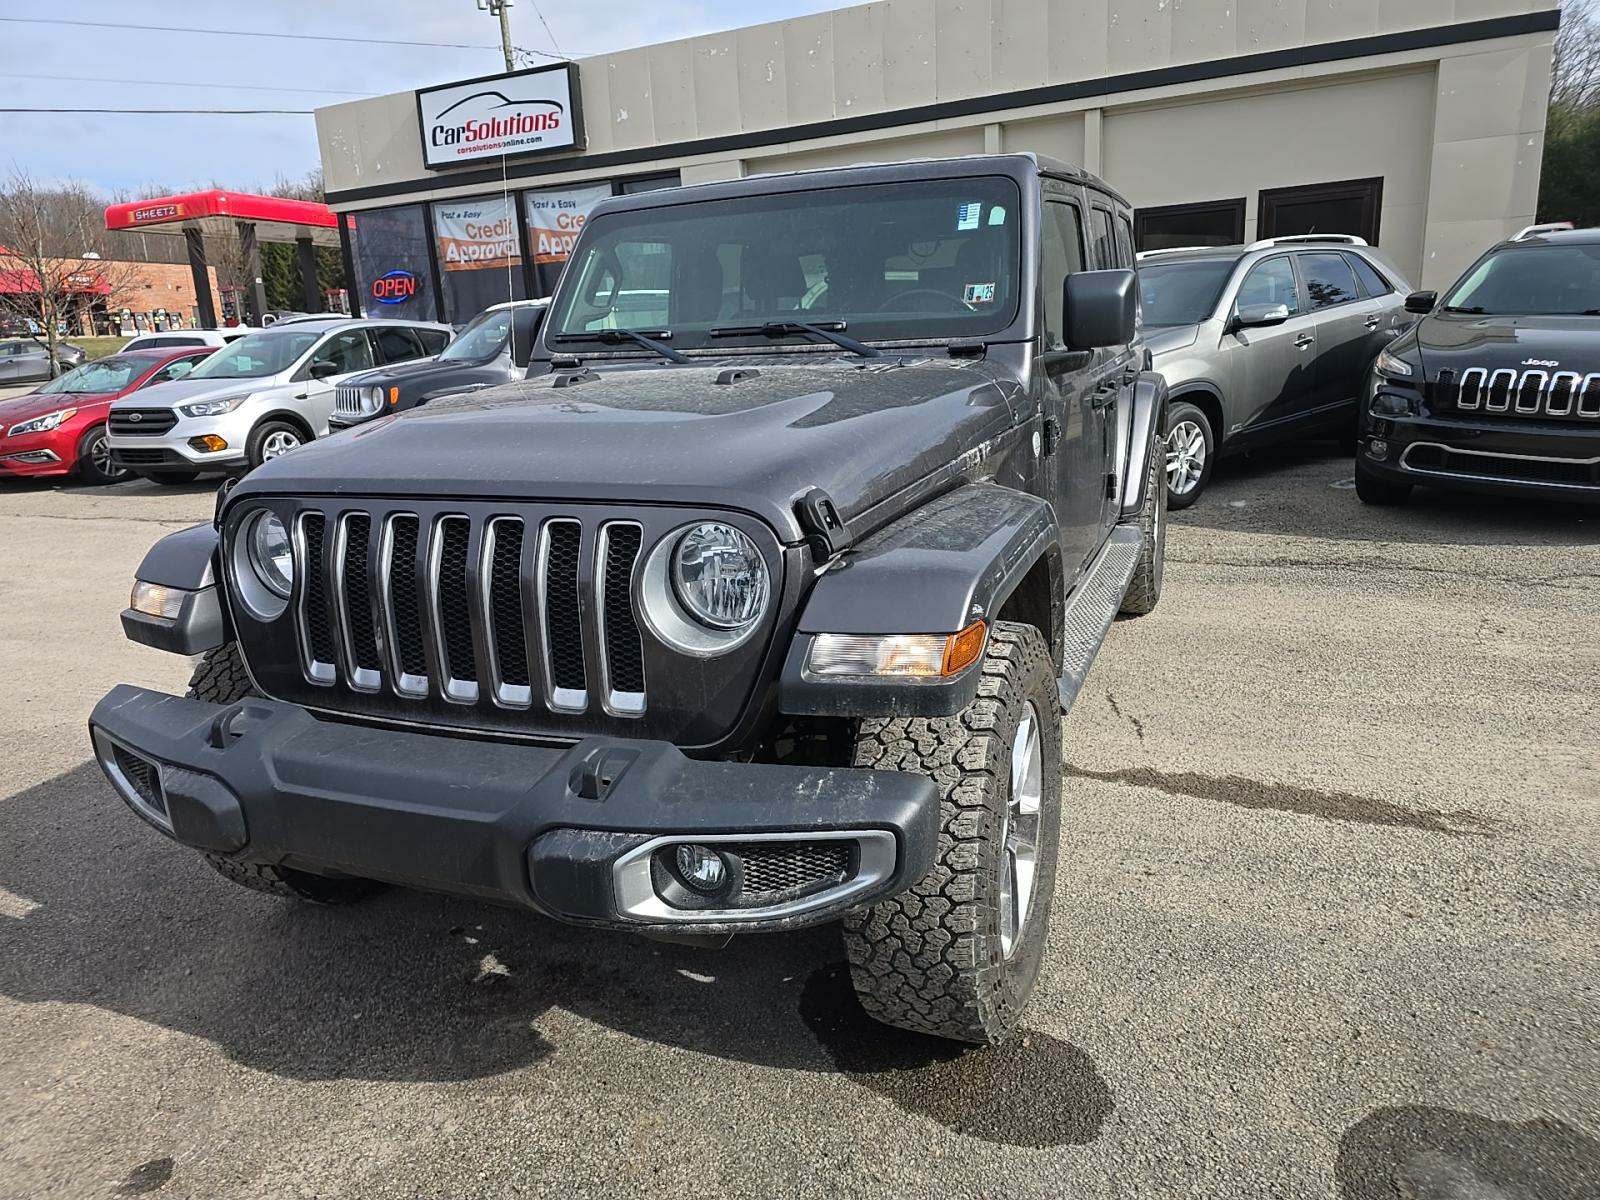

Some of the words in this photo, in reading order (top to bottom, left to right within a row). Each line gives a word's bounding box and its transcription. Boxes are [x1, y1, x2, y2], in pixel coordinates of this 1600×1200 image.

[432, 111, 560, 147] CarSolutions
[457, 136, 543, 155] carsolutionsonline.com
[135, 206, 176, 220] SHEETZ
[557, 199, 576, 209] Easy
[463, 210, 481, 219] Easy
[557, 212, 586, 229] Cre
[465, 217, 512, 240] Credit
[446, 238, 521, 265] Approval
[373, 277, 415, 297] OPEN
[1520, 358, 1559, 368] Jeep
